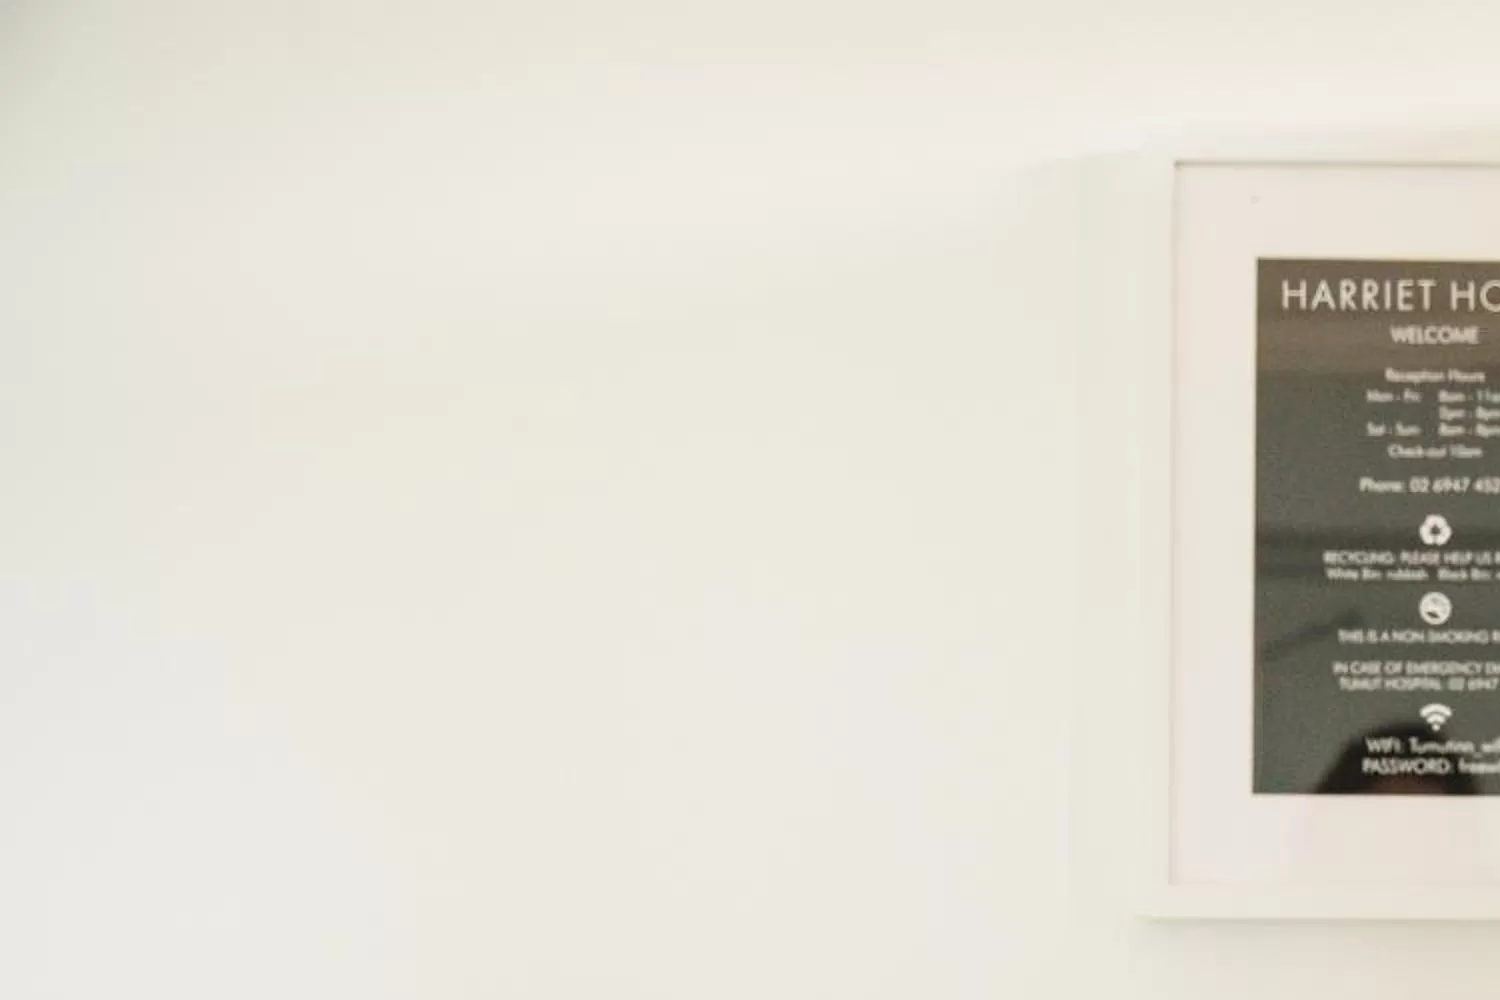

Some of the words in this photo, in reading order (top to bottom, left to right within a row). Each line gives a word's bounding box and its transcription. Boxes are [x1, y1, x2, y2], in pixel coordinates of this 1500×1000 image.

[1281, 279, 1437, 312] HARRIET
[1390, 326, 1480, 344] WELCOME
[1385, 368, 1445, 384] Reception
[1448, 368, 1485, 382] Hours
[1366, 389, 1394, 403] Mon
[1366, 422, 1386, 437] Sat
[1359, 477, 1405, 494] Phone:
[1408, 477, 1430, 493] 02
[1400, 550, 1441, 565] PLEASE
[1443, 550, 1473, 565] HELP
[1475, 550, 1492, 565] US
[1326, 567, 1360, 581] White
[1386, 567, 1429, 581] rubbish
[1437, 567, 1468, 582] Black
[1338, 629, 1364, 644] THIS
[1366, 629, 1378, 644] IS
[1380, 629, 1390, 644] A
[1333, 661, 1349, 675] IN
[1350, 661, 1381, 675] CASE
[1383, 661, 1403, 675] OF
[1405, 661, 1483, 675] EMERGENCY
[1339, 677, 1382, 691] TUMUT
